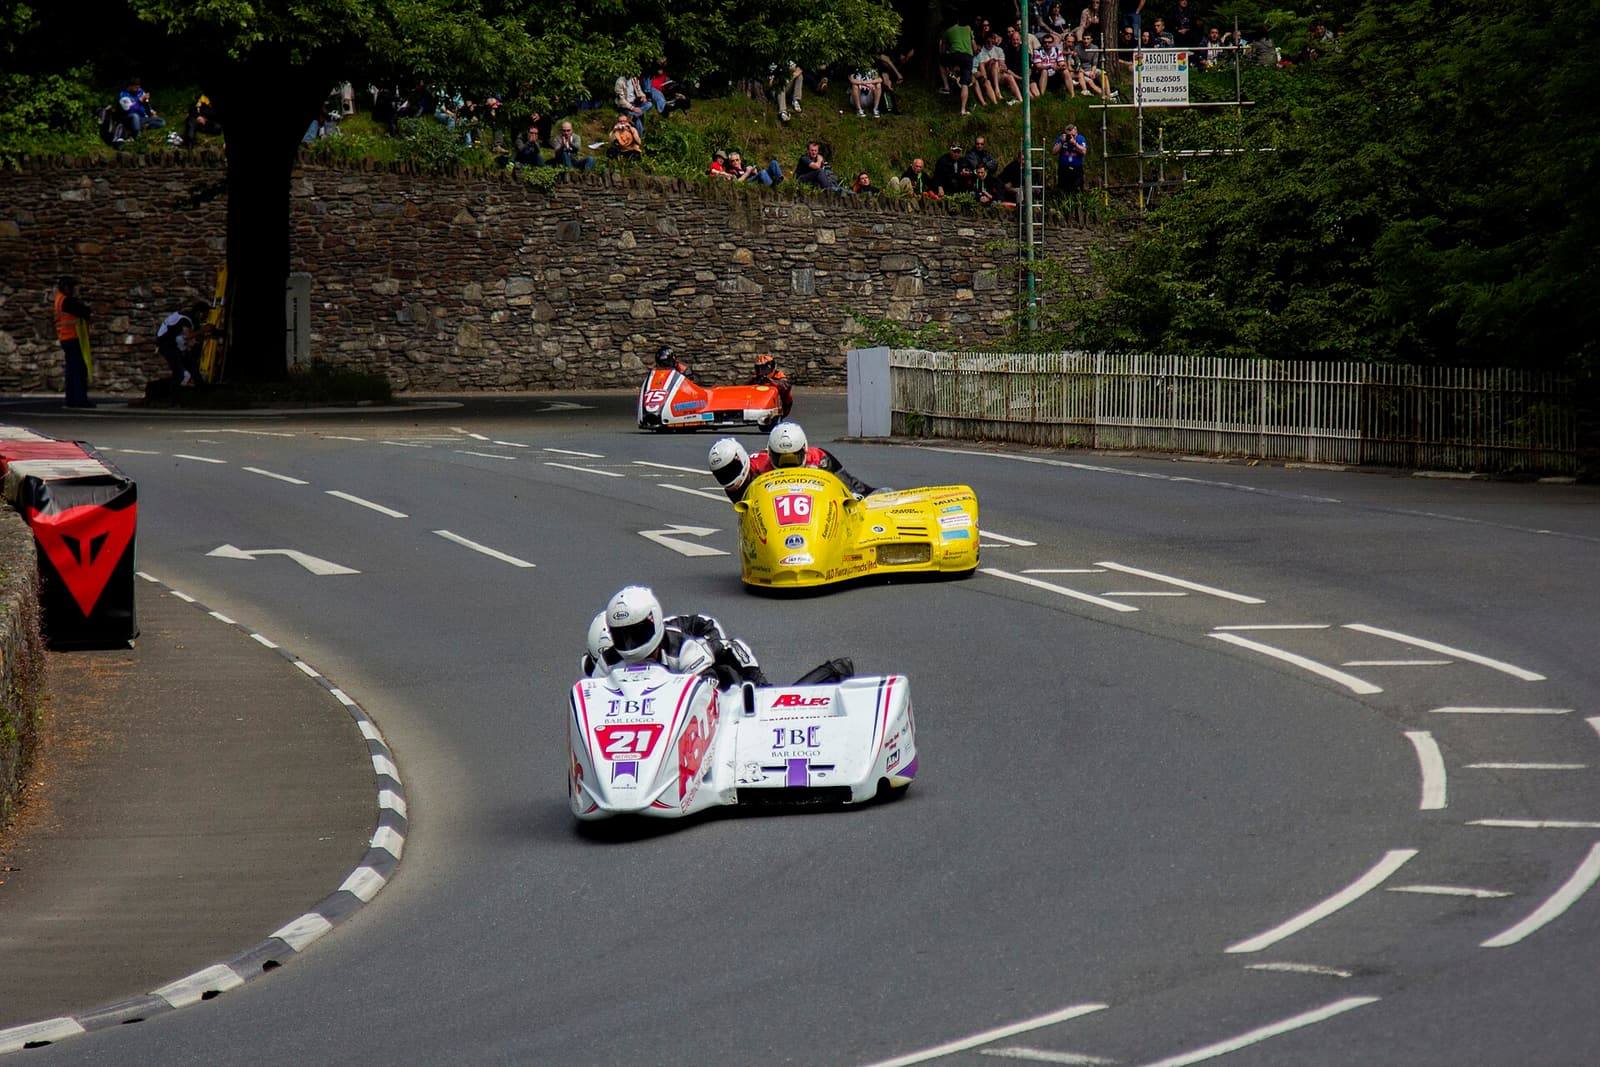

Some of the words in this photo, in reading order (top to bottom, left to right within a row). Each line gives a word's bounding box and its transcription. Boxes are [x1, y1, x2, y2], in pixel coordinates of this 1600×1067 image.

[1145, 53, 1177, 64] ABSOLUTE
[645, 391, 666, 402] 15
[779, 497, 810, 516] 16
[771, 694, 831, 708] ABLEC
[605, 730, 653, 753] 21
